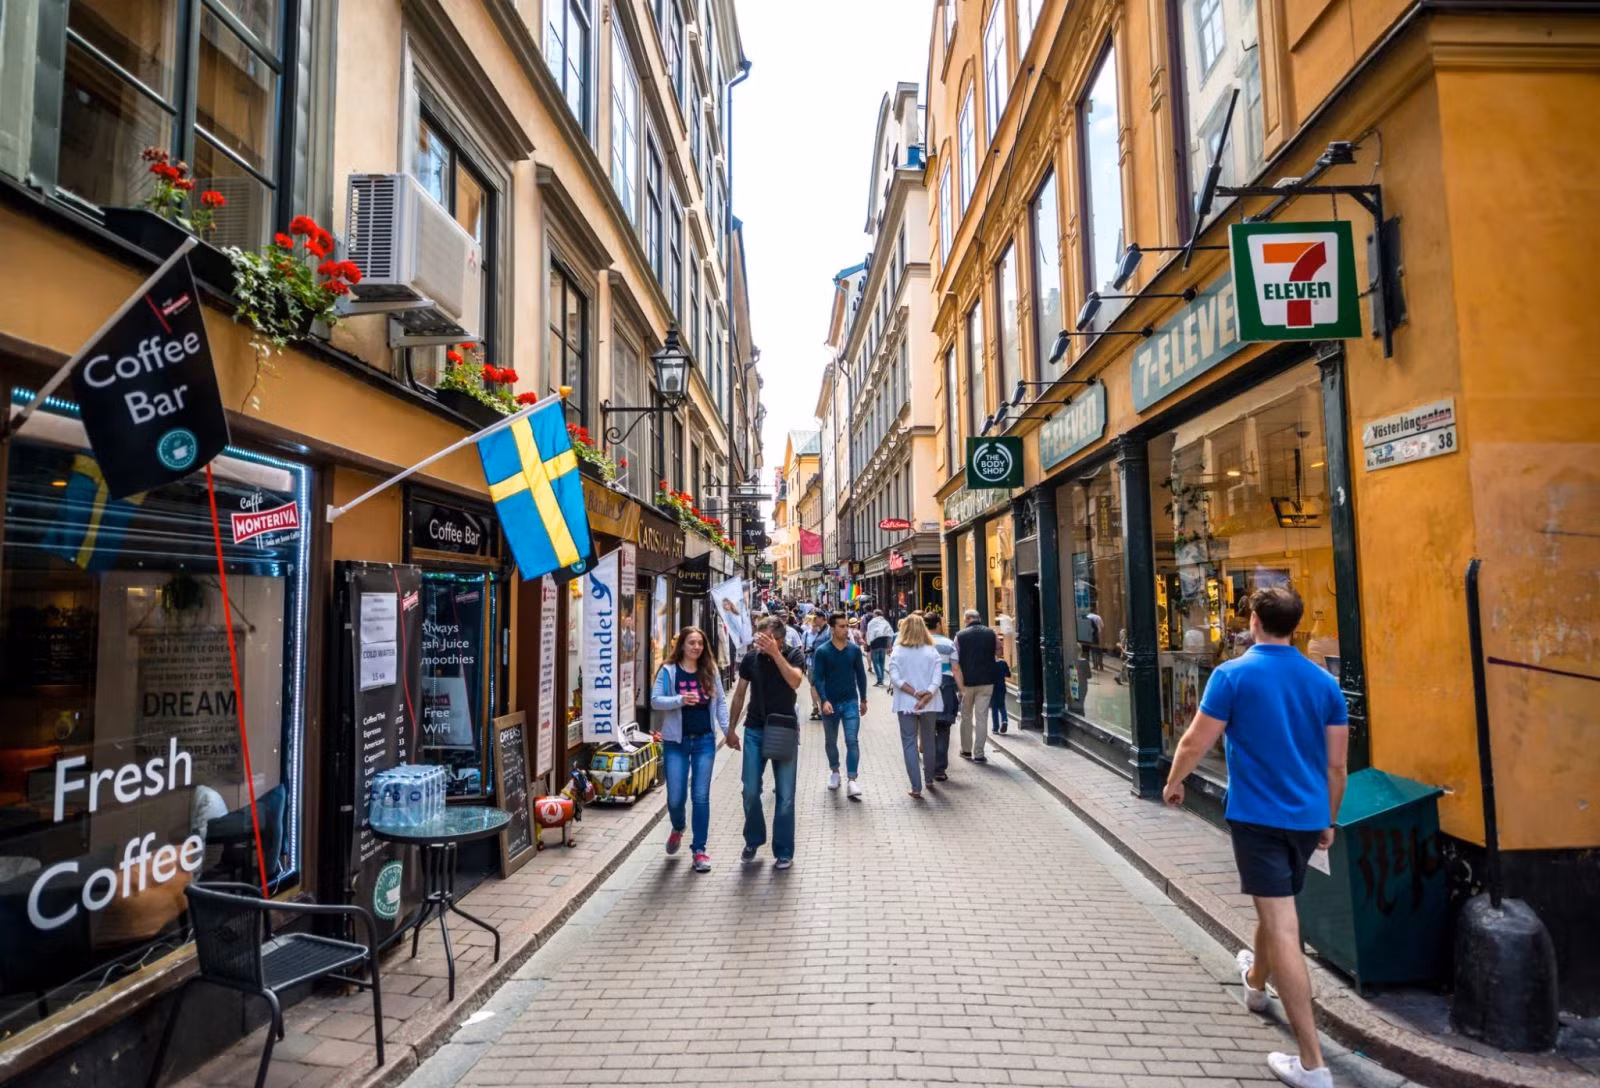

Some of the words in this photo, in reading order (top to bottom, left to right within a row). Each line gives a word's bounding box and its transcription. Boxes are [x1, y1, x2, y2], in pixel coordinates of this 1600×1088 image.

[1262, 241, 1327, 326] 7
[1138, 281, 1236, 400] 7-ELEVE
[83, 331, 200, 388] Coffee
[124, 385, 188, 425] Bar
[1438, 432, 1453, 449] 38
[980, 460, 1006, 468] BODY
[982, 467, 1005, 475] SHOP
[236, 508, 297, 537] MONTERIVA
[429, 519, 462, 543] Coffee
[465, 525, 480, 546] Bar
[421, 623, 459, 635] Always
[591, 583, 612, 690] Bandet
[439, 638, 470, 652] Juice
[421, 654, 474, 664] moothies
[142, 690, 238, 717] DREAM
[424, 707, 450, 718] Free
[422, 723, 450, 735] WiFi
[593, 703, 612, 735] Blå
[53, 737, 192, 823] Fresh
[27, 832, 203, 931] Coffee
